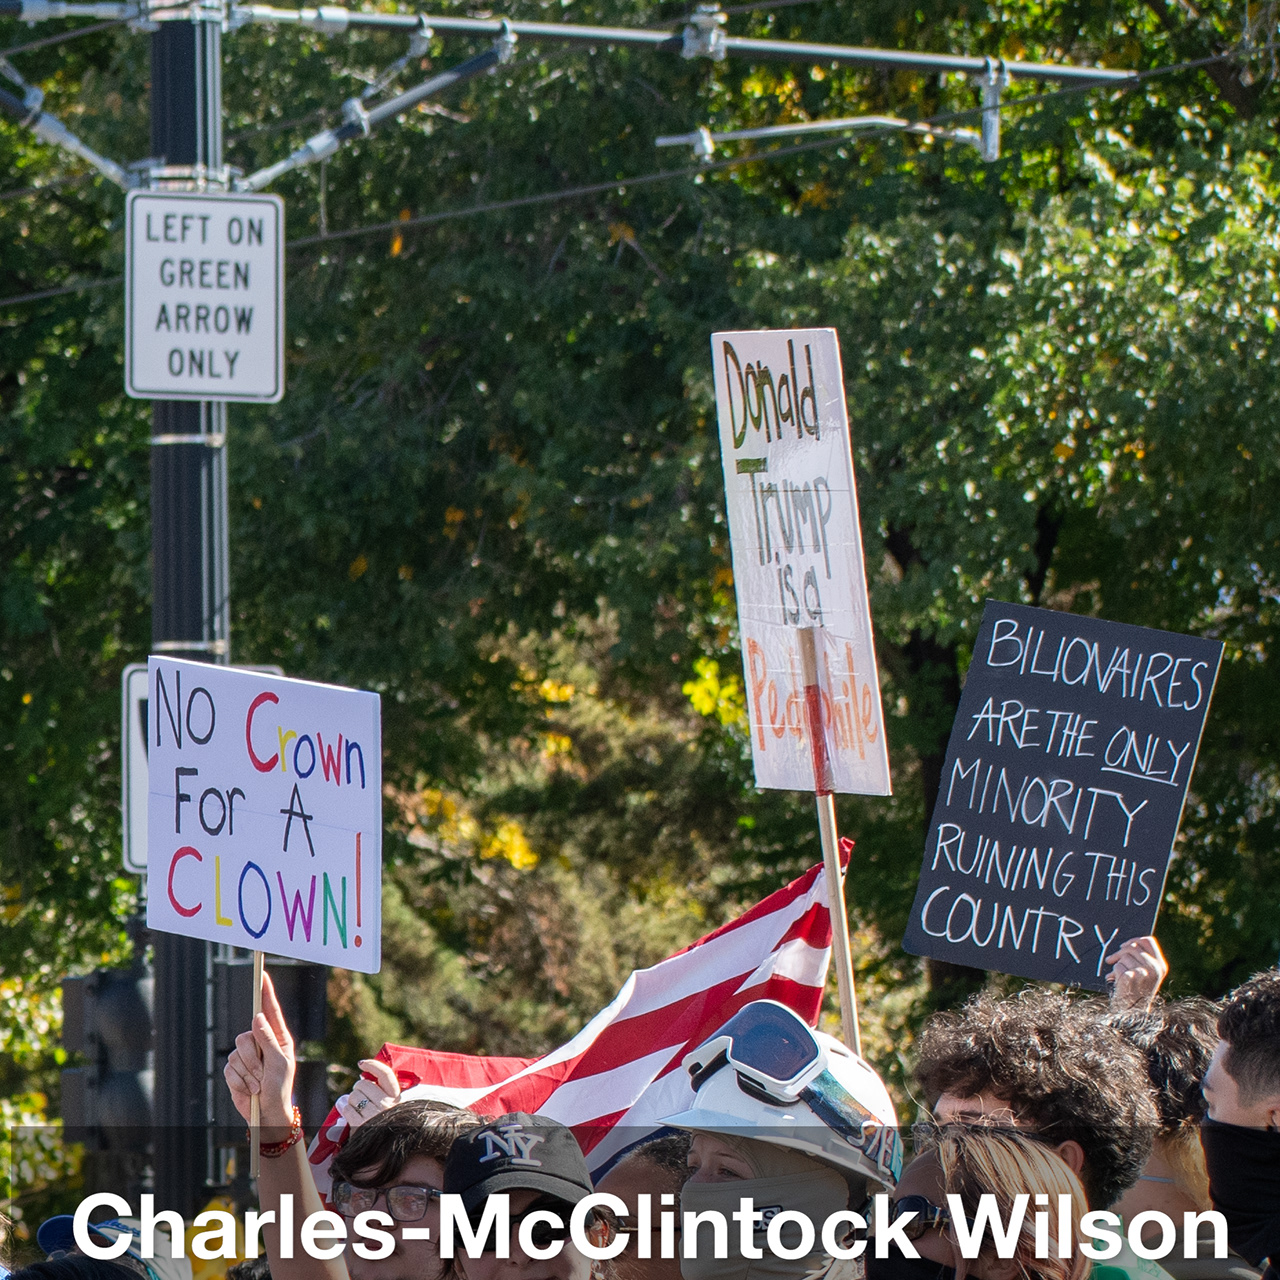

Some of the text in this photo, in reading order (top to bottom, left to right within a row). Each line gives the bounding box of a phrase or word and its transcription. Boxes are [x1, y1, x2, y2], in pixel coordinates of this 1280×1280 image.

[145, 213, 263, 246] LEFT ON
[159, 258, 250, 290] GREEN
[155, 303, 254, 335] ARROW
[167, 348, 239, 379] ONLY
[722, 338, 820, 450] Donald
[735, 457, 831, 579] Trump
[775, 552, 824, 628] is a
[155, 666, 365, 789] NO Crown
[967, 697, 1190, 783] ARE THE ONLY
[175, 766, 314, 857] For A
[946, 757, 1148, 848] MINORITY
[167, 831, 362, 949] CLOWN!
[931, 823, 1156, 906] RUINING THIS
[921, 886, 1119, 977] COUNTRY
[478, 1124, 545, 1167] NY
